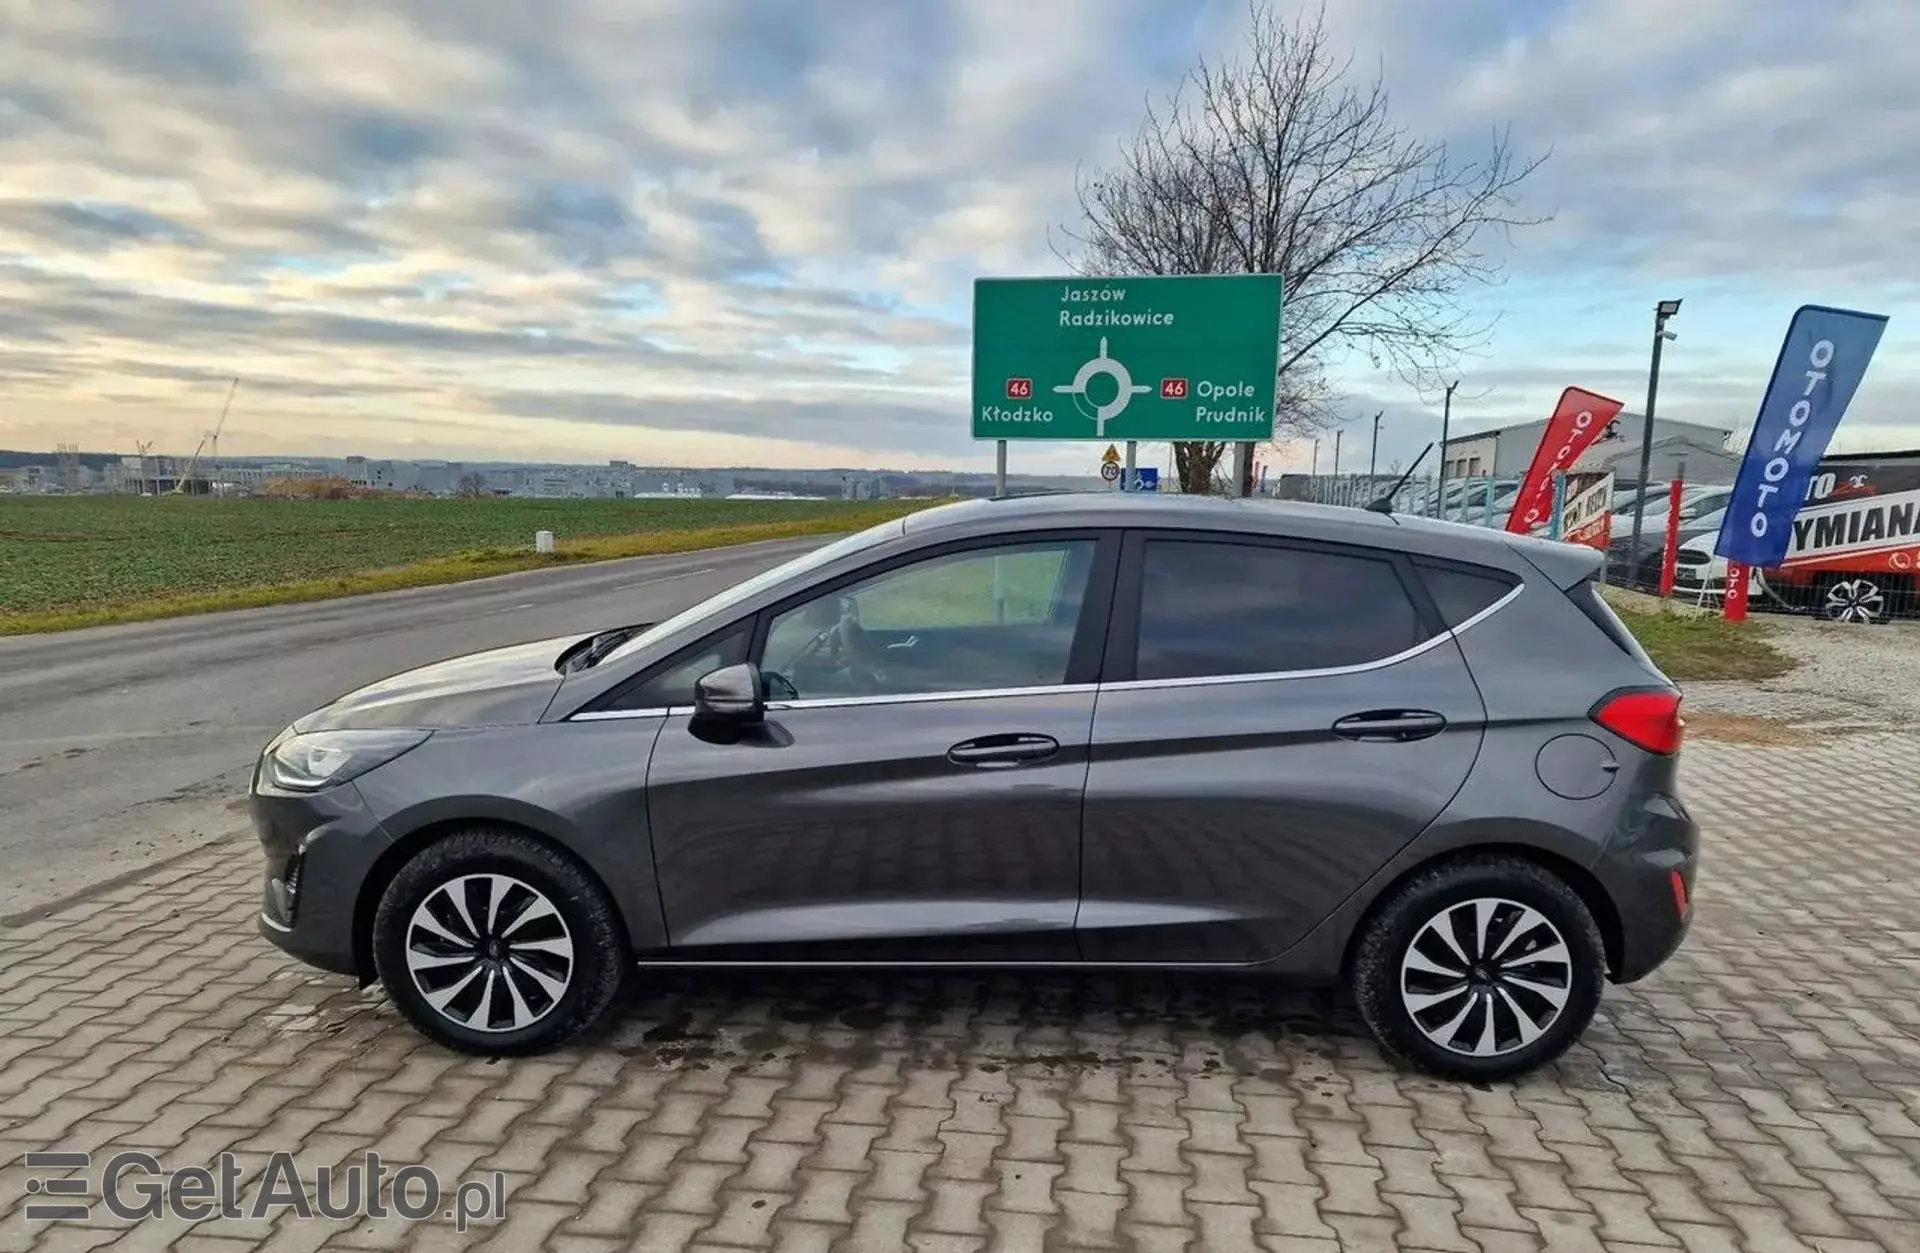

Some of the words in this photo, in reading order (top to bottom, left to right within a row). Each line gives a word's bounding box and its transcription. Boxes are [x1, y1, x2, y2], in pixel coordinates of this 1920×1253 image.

[1060, 284, 1126, 302] Jaszów
[1059, 309, 1175, 327] Radzikowice
[1008, 382, 1029, 396] 46
[1164, 381, 1184, 395] 46
[1196, 380, 1255, 399] Opole
[981, 405, 1054, 423] Kłodzko
[1196, 405, 1267, 424] Prudnik
[1750, 339, 1835, 538] OTOMOTO
